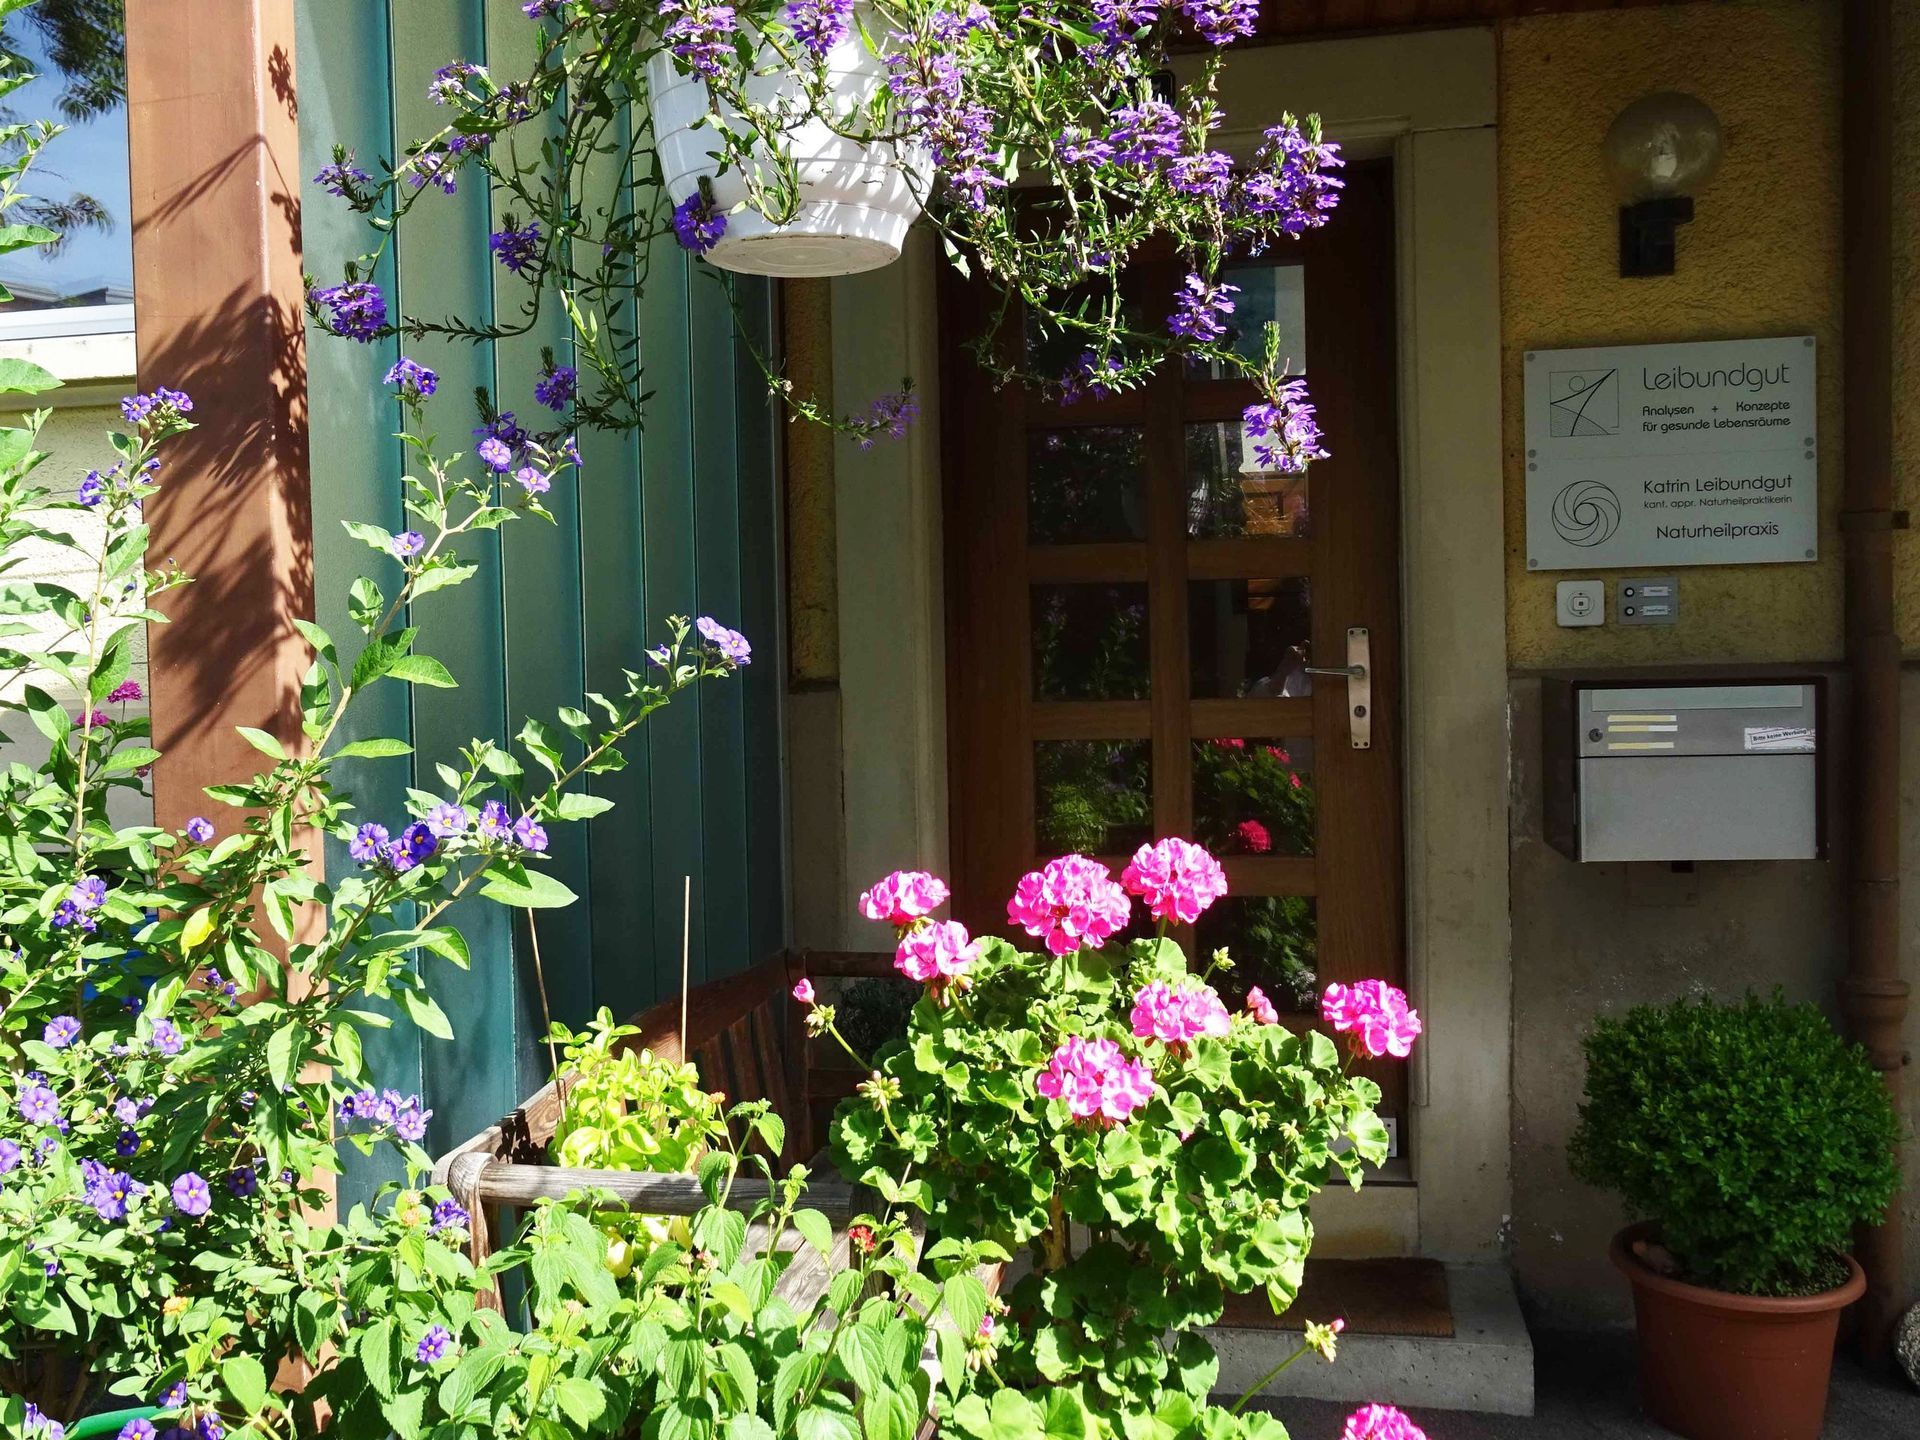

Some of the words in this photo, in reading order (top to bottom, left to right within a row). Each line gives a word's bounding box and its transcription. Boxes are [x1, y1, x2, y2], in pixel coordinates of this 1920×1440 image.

[1643, 362, 1791, 393] Leibundgut
[1642, 405, 1695, 418] Analysen
[1711, 405, 1719, 413] +
[1736, 401, 1791, 413] Konzepte
[1642, 421, 1657, 432] für
[1660, 419, 1711, 434] gesunde
[1713, 416, 1792, 430] Lebensräume
[1643, 479, 1690, 494] Katrin
[1696, 474, 1793, 493] Leibundgut
[1643, 500, 1668, 509] kant.
[1670, 499, 1697, 510] appr.
[1699, 494, 1793, 507] Naturheilpraktikerin
[1656, 521, 1780, 540] Naturheilpraxis
